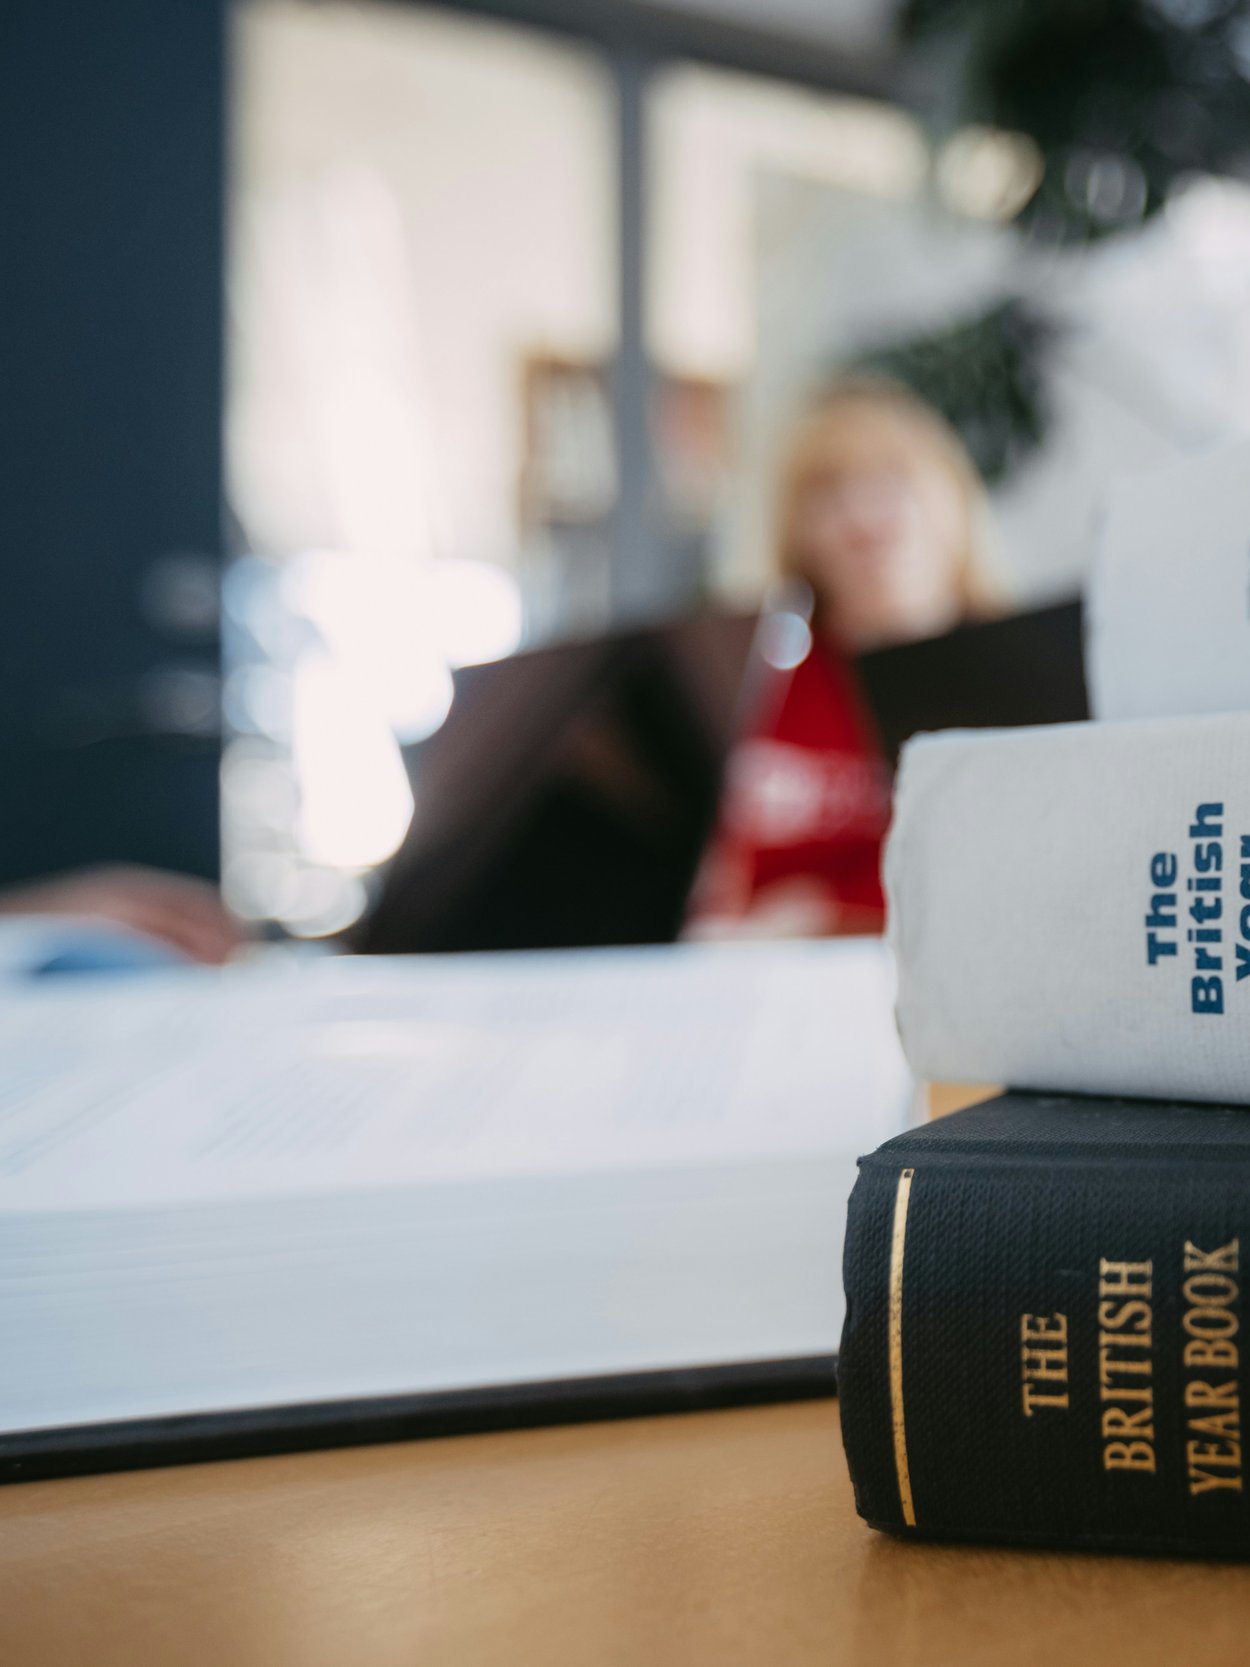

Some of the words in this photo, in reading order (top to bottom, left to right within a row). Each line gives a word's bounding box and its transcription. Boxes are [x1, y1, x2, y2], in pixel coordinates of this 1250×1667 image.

[1145, 852, 1178, 965] The
[1188, 802, 1224, 1014] British
[1182, 1238, 1239, 1367] BOOK
[1021, 1312, 1069, 1417] THE
[1100, 1258, 1156, 1473] BRITISH
[1184, 1379, 1243, 1496] YEAR
